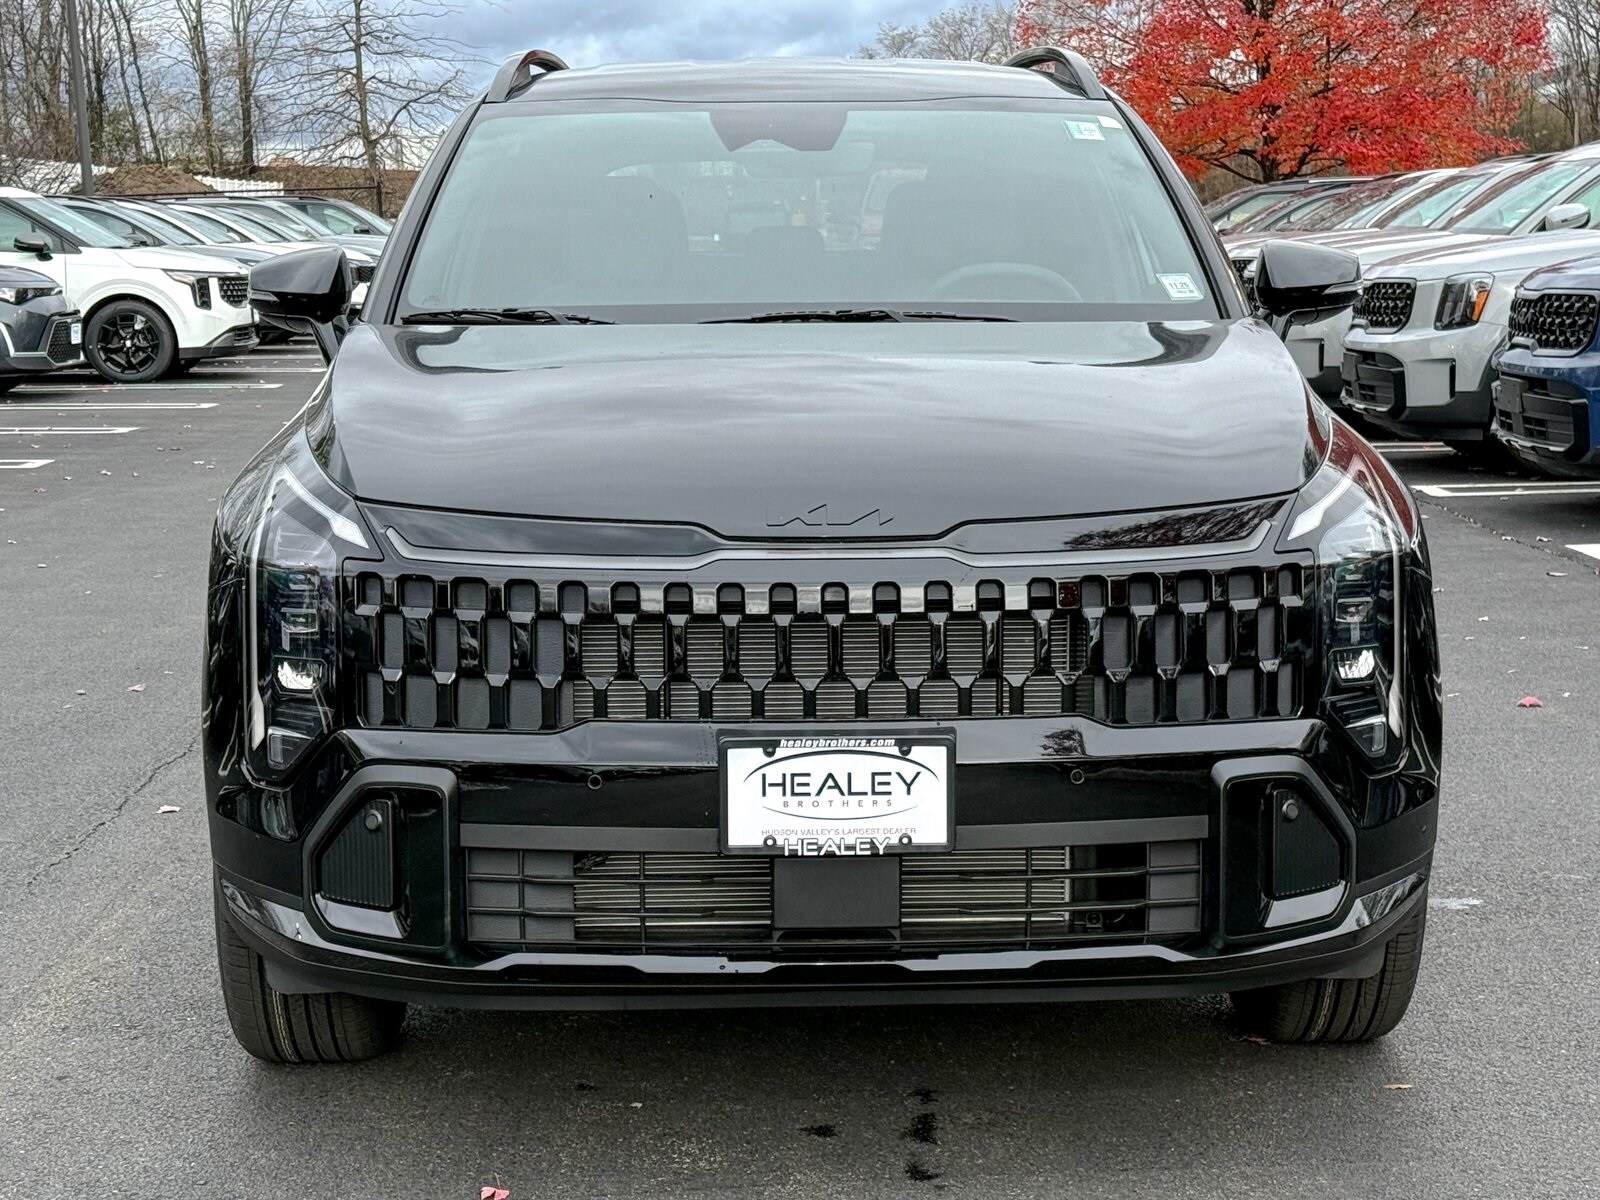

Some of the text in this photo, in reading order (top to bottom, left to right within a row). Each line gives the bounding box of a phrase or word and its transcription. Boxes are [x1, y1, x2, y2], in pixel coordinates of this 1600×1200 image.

[779, 738, 896, 749] healeybrothers.com
[761, 771, 921, 798] HEALEY
[783, 799, 892, 808] BROTHERS
[761, 828, 798, 836] HUDSON
[800, 828, 840, 836] VALLEY'S
[842, 828, 881, 836] LARGEST
[784, 837, 891, 856] HEALEY
